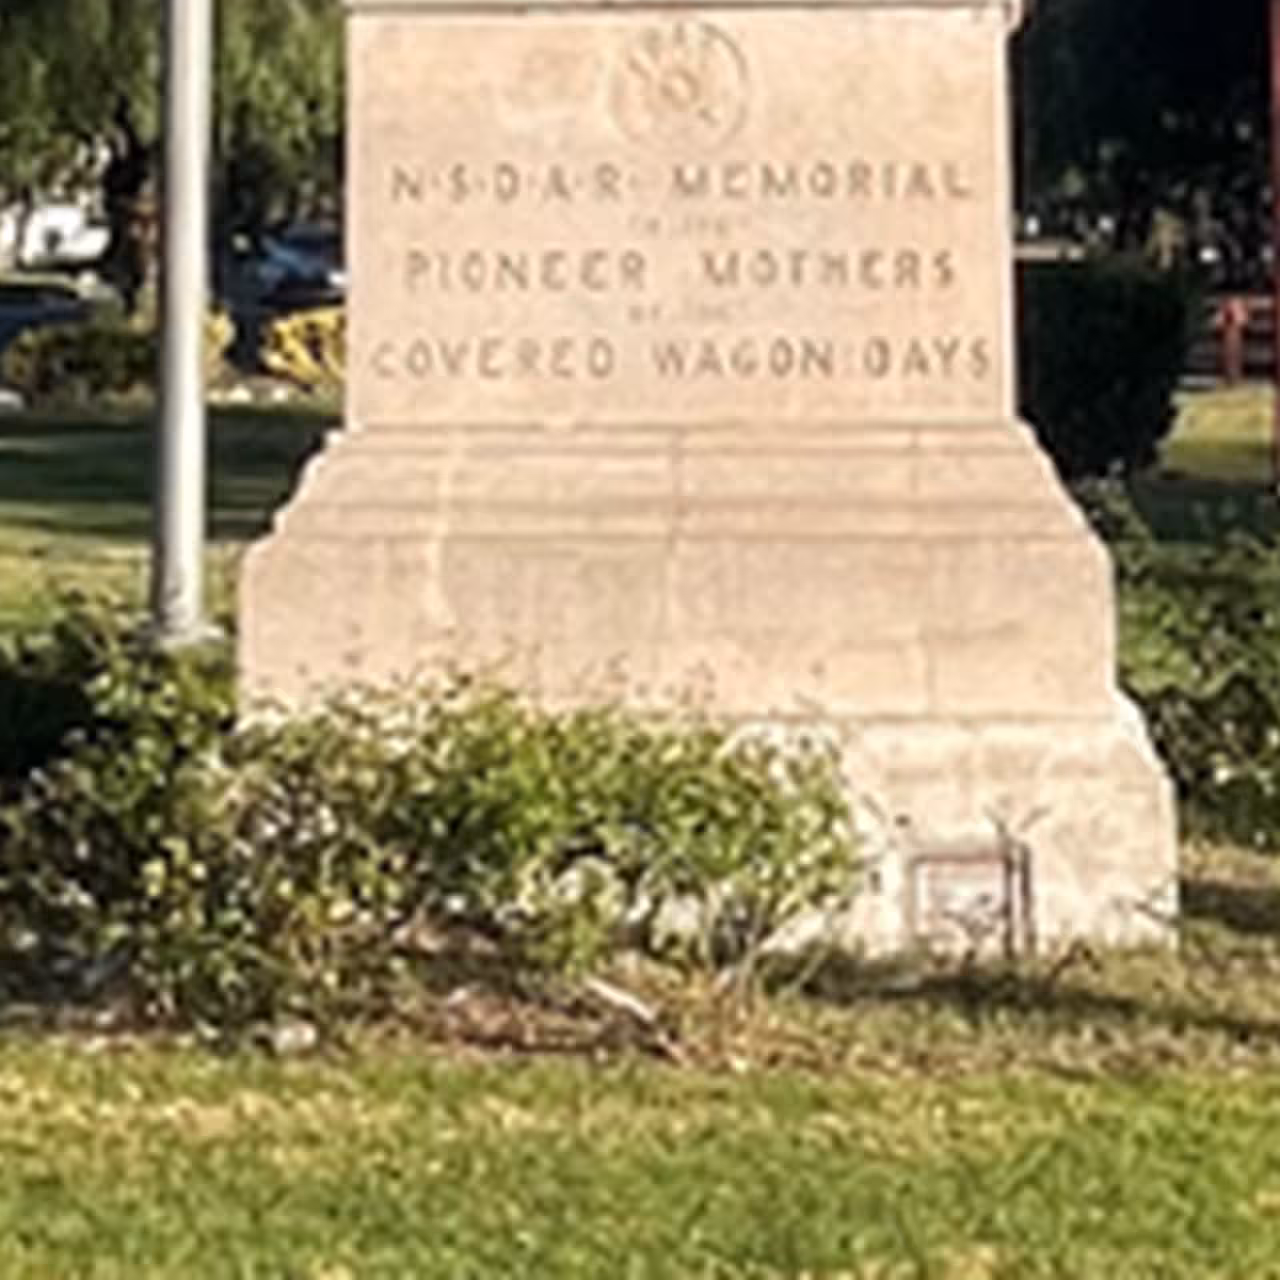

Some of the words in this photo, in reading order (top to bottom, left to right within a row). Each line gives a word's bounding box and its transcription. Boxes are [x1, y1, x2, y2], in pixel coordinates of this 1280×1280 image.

[674, 160, 971, 198] MEMORIAL
[405, 248, 645, 291] PIONEER
[703, 248, 954, 288] MOTHERS
[372, 337, 615, 378] COVERED
[651, 338, 833, 377] WAGON
[865, 336, 988, 379] DAYS
